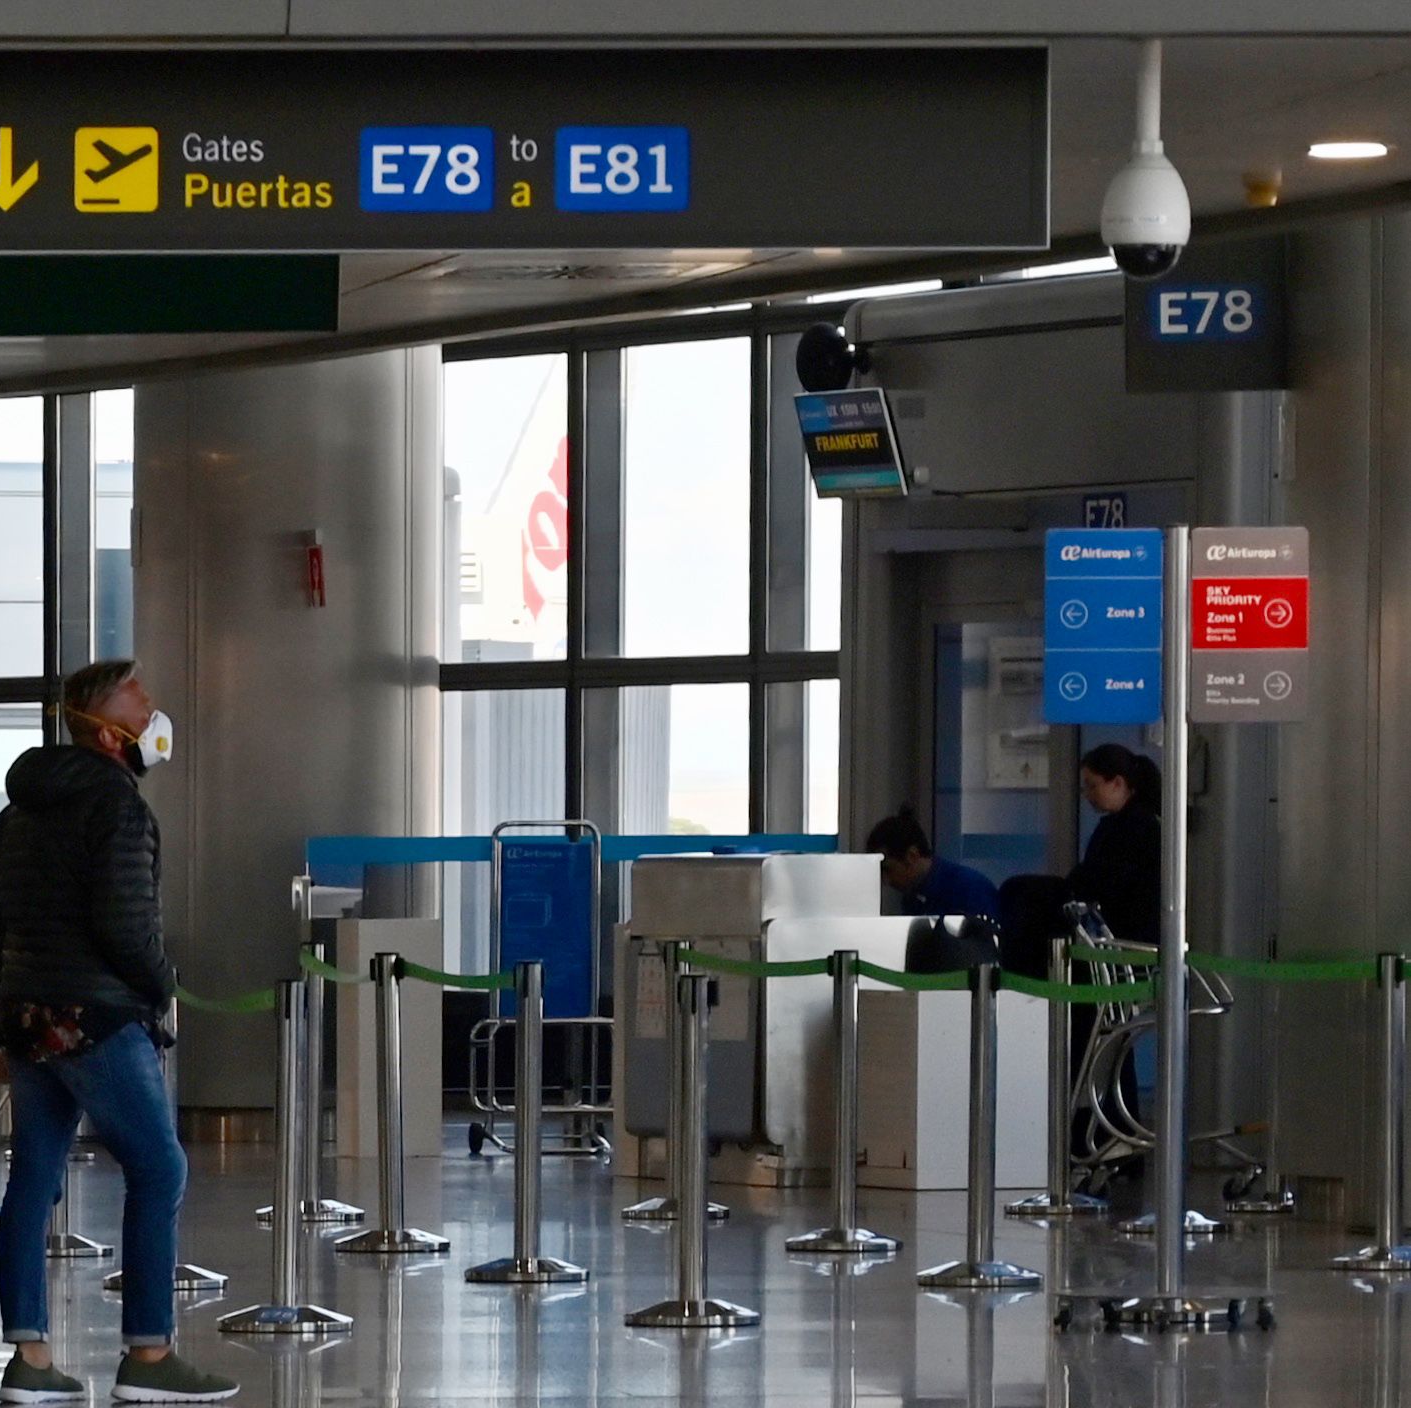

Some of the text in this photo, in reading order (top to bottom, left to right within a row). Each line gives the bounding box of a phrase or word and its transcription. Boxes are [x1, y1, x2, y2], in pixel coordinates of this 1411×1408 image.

[182, 132, 265, 163] Gates
[509, 134, 538, 162] to
[372, 144, 481, 195] E78
[569, 144, 673, 194] E81
[183, 172, 332, 208] Puertas
[510, 181, 531, 208] a
[1159, 290, 1253, 335] E78
[815, 432, 880, 453] FRANKFURT
[1227, 547, 1277, 560] AirEuropa
[1206, 585, 1231, 595] SKY
[1206, 595, 1262, 606] PRIORITY
[1106, 606, 1146, 618] Zone 3
[1206, 611, 1244, 624] Zone 1
[1105, 678, 1145, 690] Zone 4
[1206, 673, 1245, 685] Zone 2
